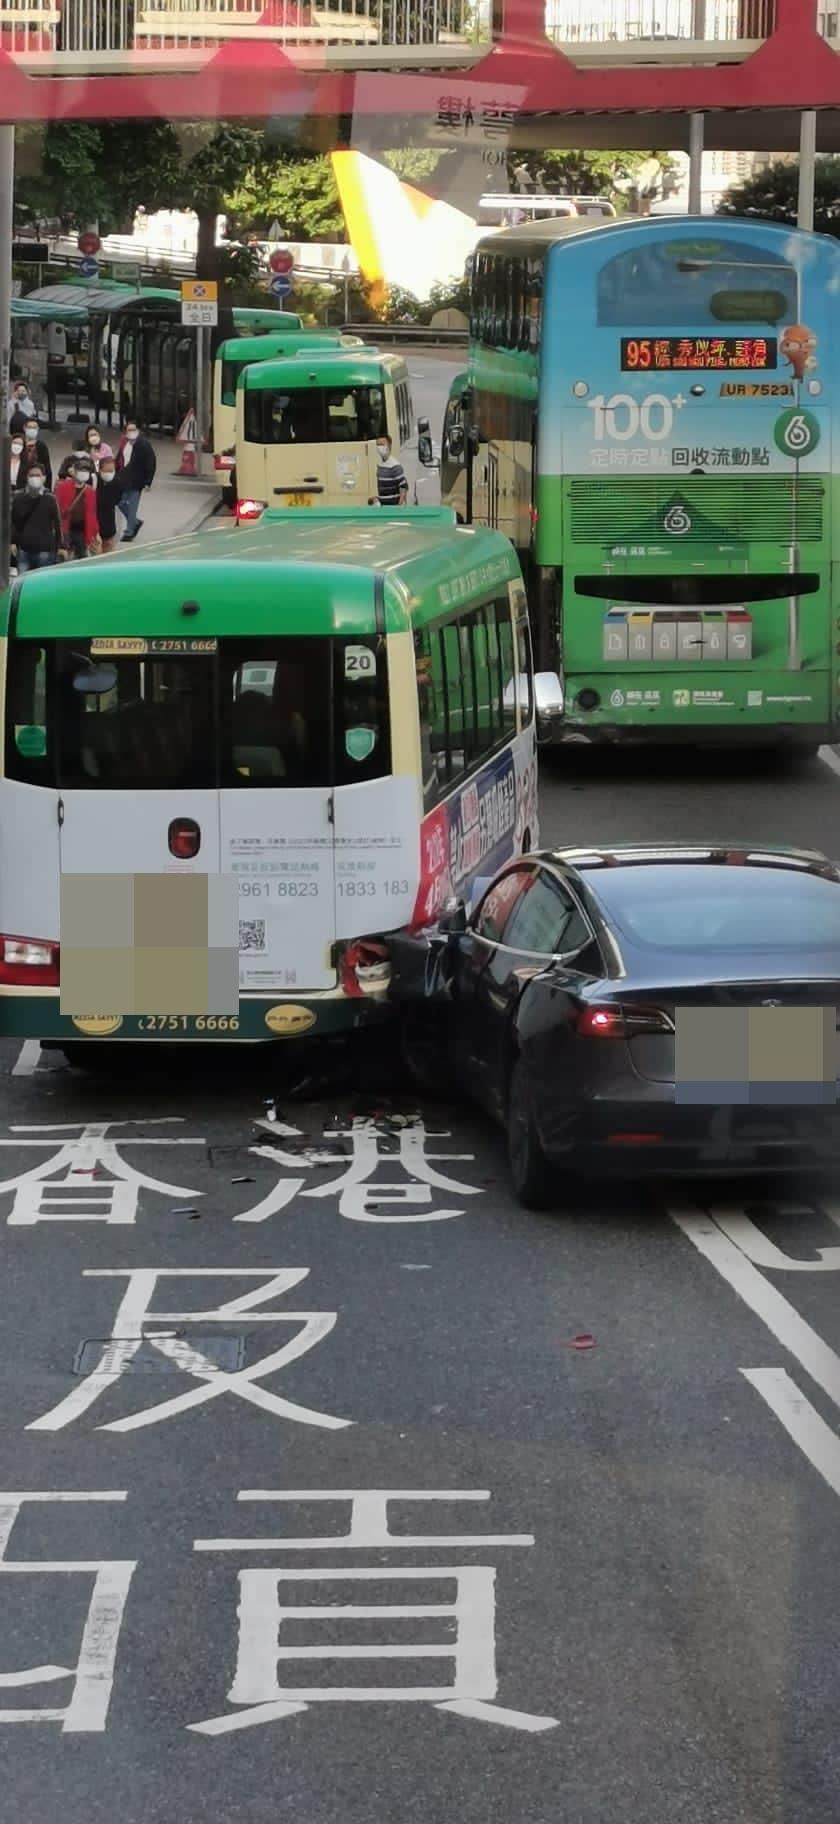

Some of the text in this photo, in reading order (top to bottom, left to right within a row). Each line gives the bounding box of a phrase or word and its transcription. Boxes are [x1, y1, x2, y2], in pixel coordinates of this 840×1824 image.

[626, 340, 651, 368] 95
[726, 383, 788, 396] UR 7523
[346, 655, 371, 671] 20
[239, 882, 319, 897] 961 8823
[337, 880, 409, 897] 1833 183
[145, 1015, 188, 1030] 2751
[195, 1015, 240, 1030] 6666
[0, 1117, 486, 1224] 香港
[25, 1268, 355, 1432] 及
